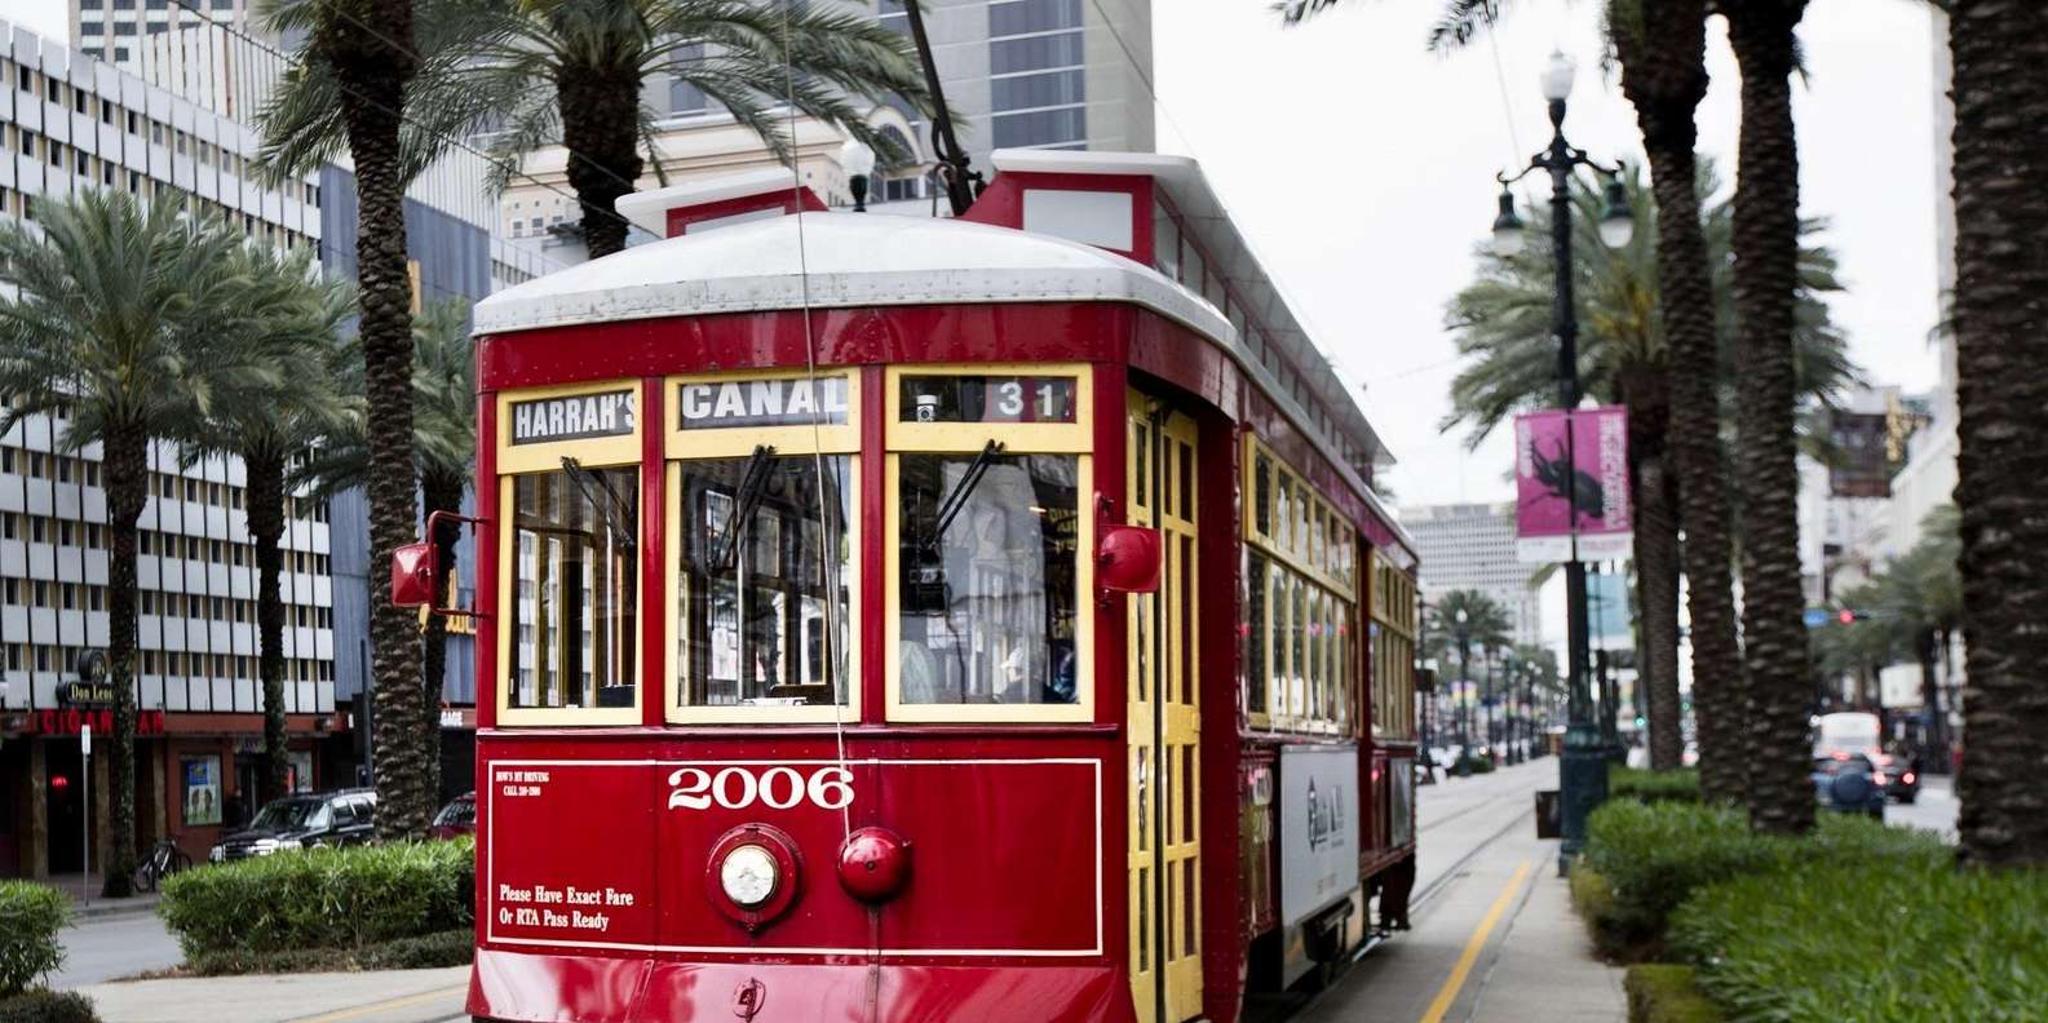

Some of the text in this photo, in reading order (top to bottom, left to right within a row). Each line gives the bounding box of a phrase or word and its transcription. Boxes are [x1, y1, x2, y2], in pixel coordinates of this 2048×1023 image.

[682, 377, 848, 419] CANAL
[516, 393, 634, 438] HARRAH'S
[71, 684, 113, 701] Don Leo
[668, 767, 855, 810] 2006
[500, 884, 634, 906] Please Have Exact Fare
[499, 907, 609, 932] Or RTA Pass Ready
